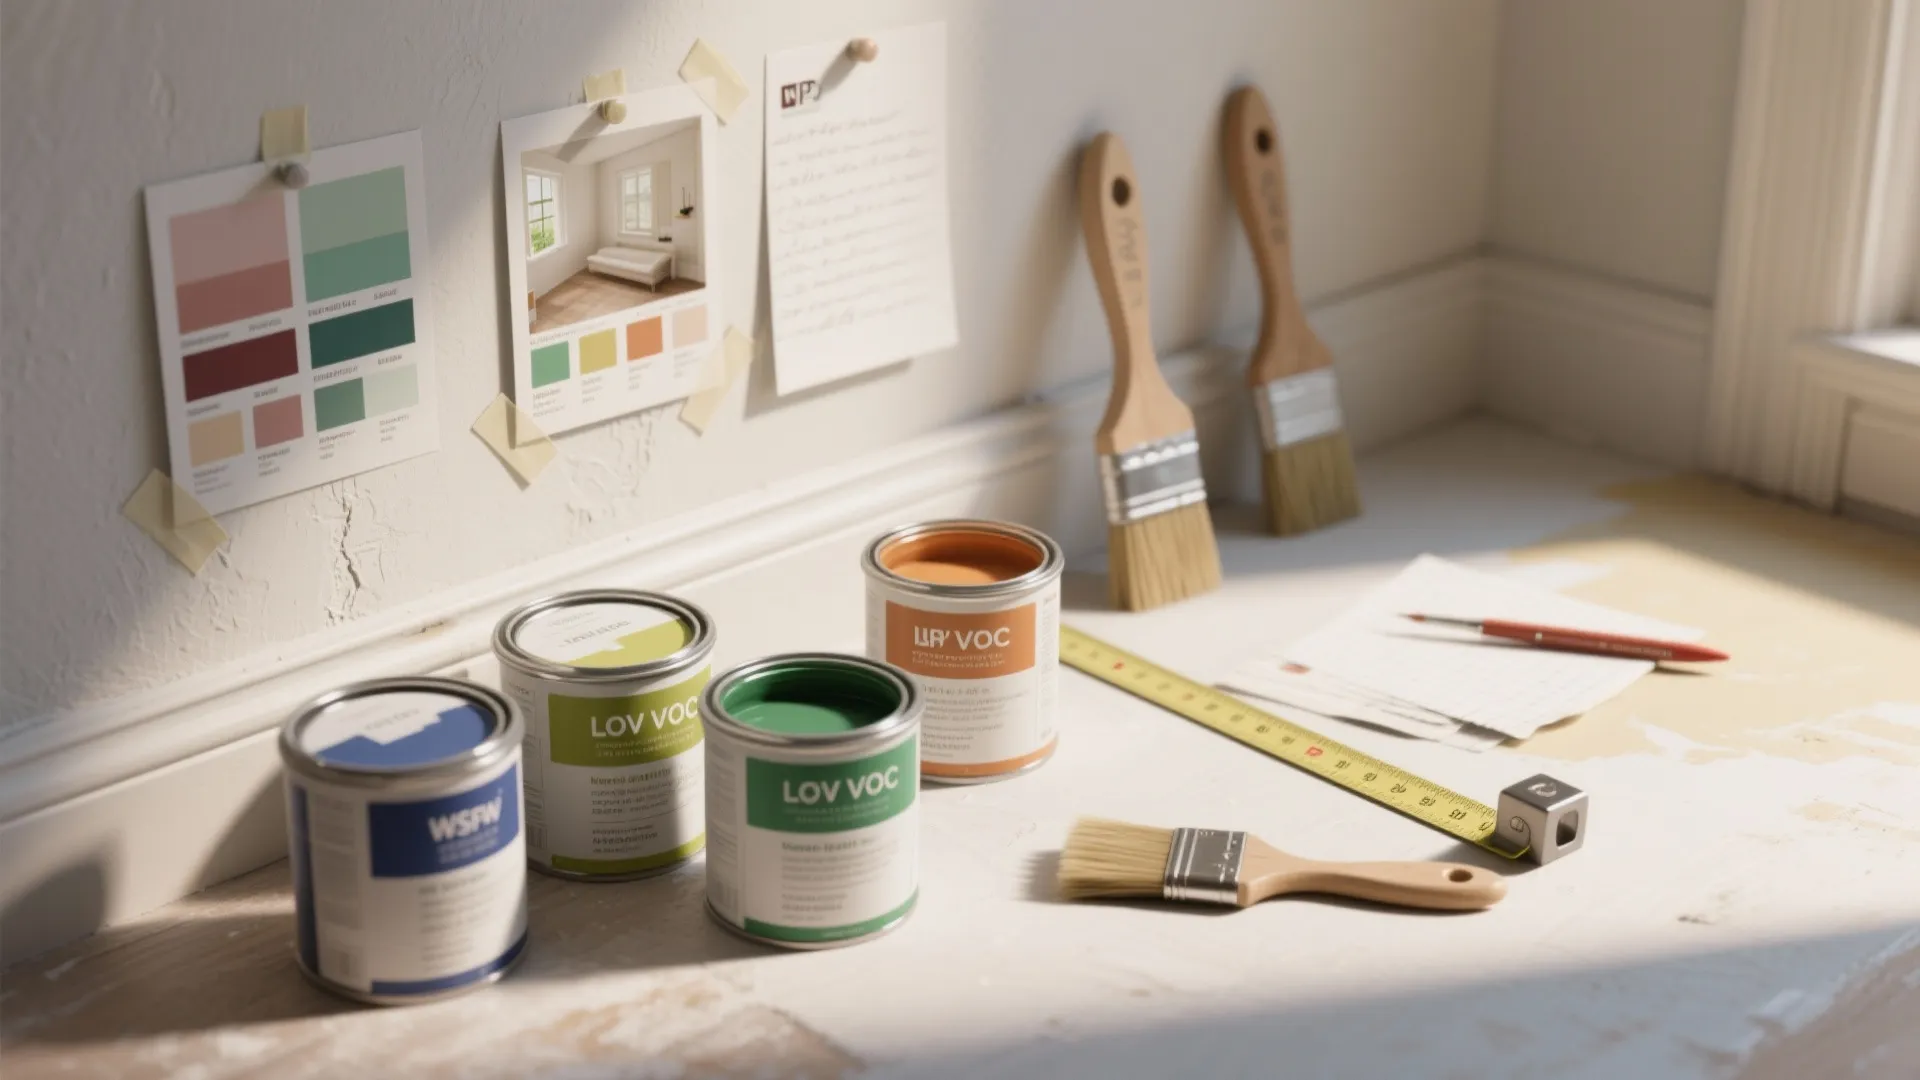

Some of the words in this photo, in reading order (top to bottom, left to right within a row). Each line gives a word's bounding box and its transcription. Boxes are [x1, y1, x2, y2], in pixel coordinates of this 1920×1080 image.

[954, 626, 1011, 651] VOC
[590, 713, 645, 738] LOV
[650, 695, 699, 730] VOC
[782, 780, 841, 805] LOV
[846, 765, 899, 800] VOC
